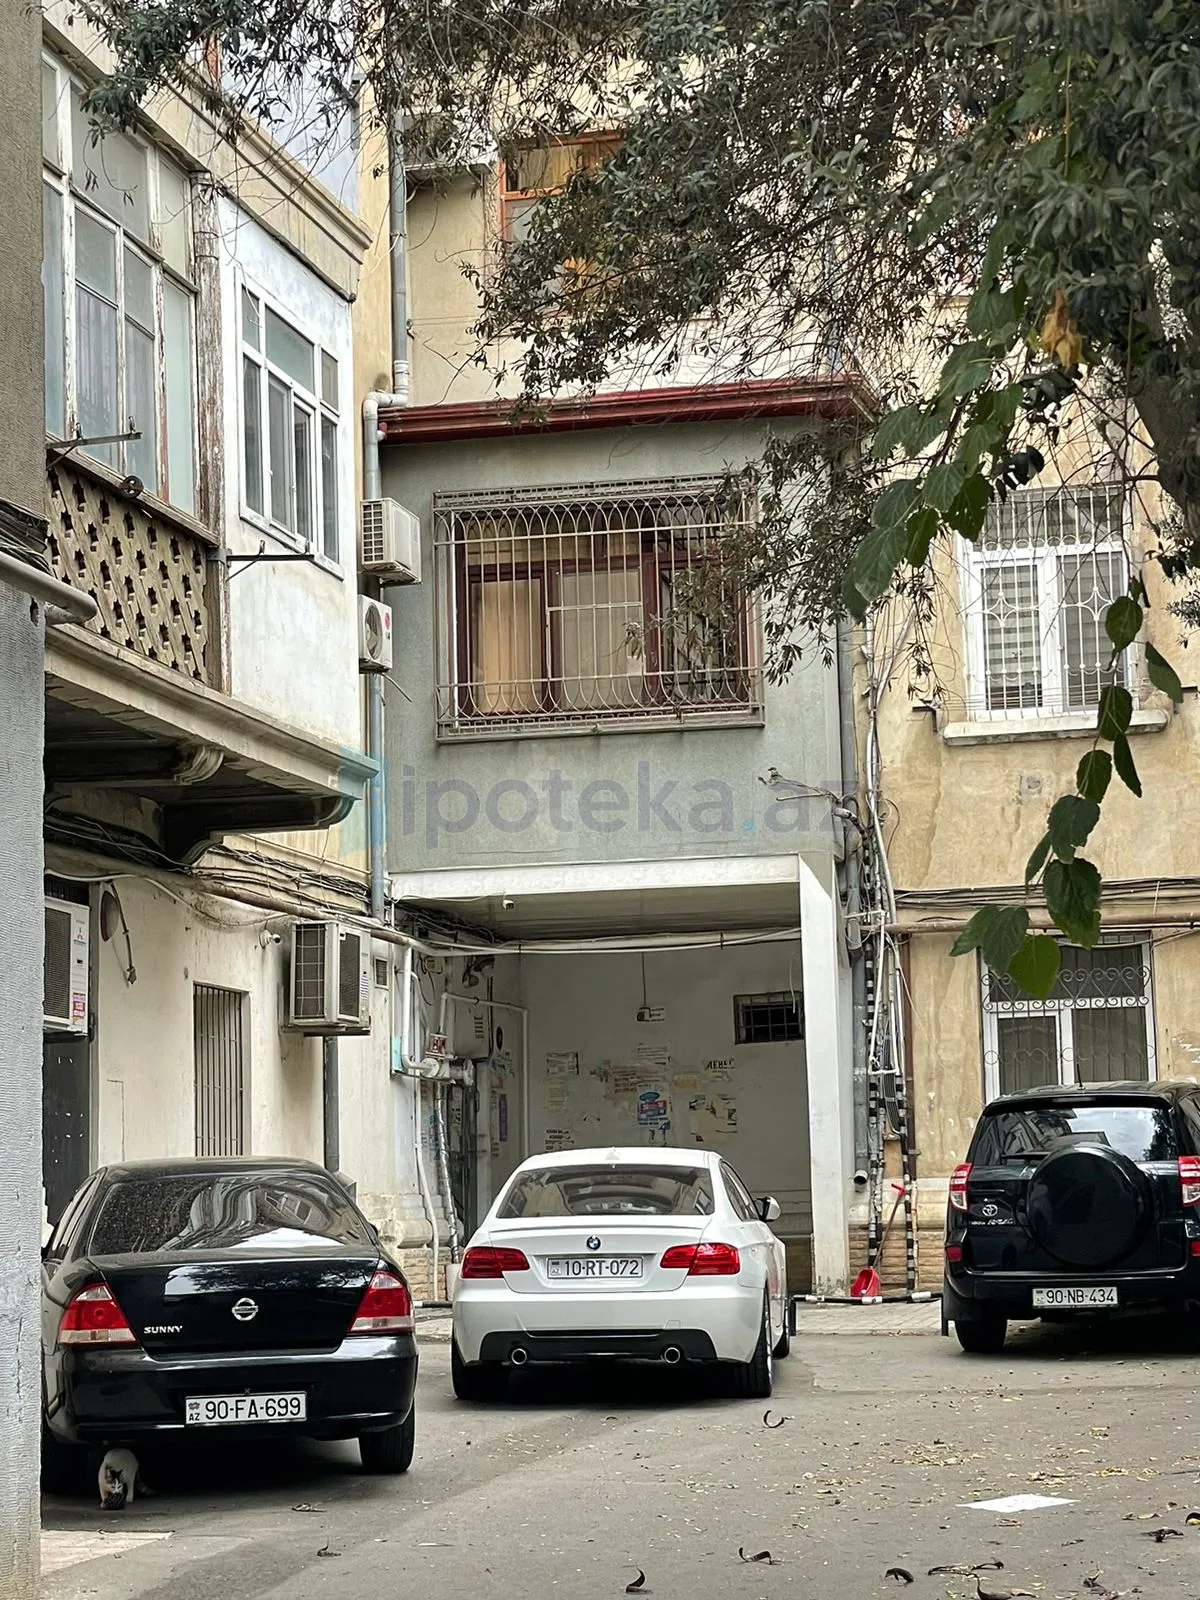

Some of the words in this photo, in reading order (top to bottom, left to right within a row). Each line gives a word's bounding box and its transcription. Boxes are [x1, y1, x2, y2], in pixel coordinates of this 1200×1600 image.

[564, 1260, 639, 1276] 10-RT-072
[1046, 1288, 1115, 1304] 90-NB-434
[143, 1325, 184, 1334] SUNNY
[205, 1397, 301, 1420] 90-FA-699
[188, 1413, 200, 1421] AZ
